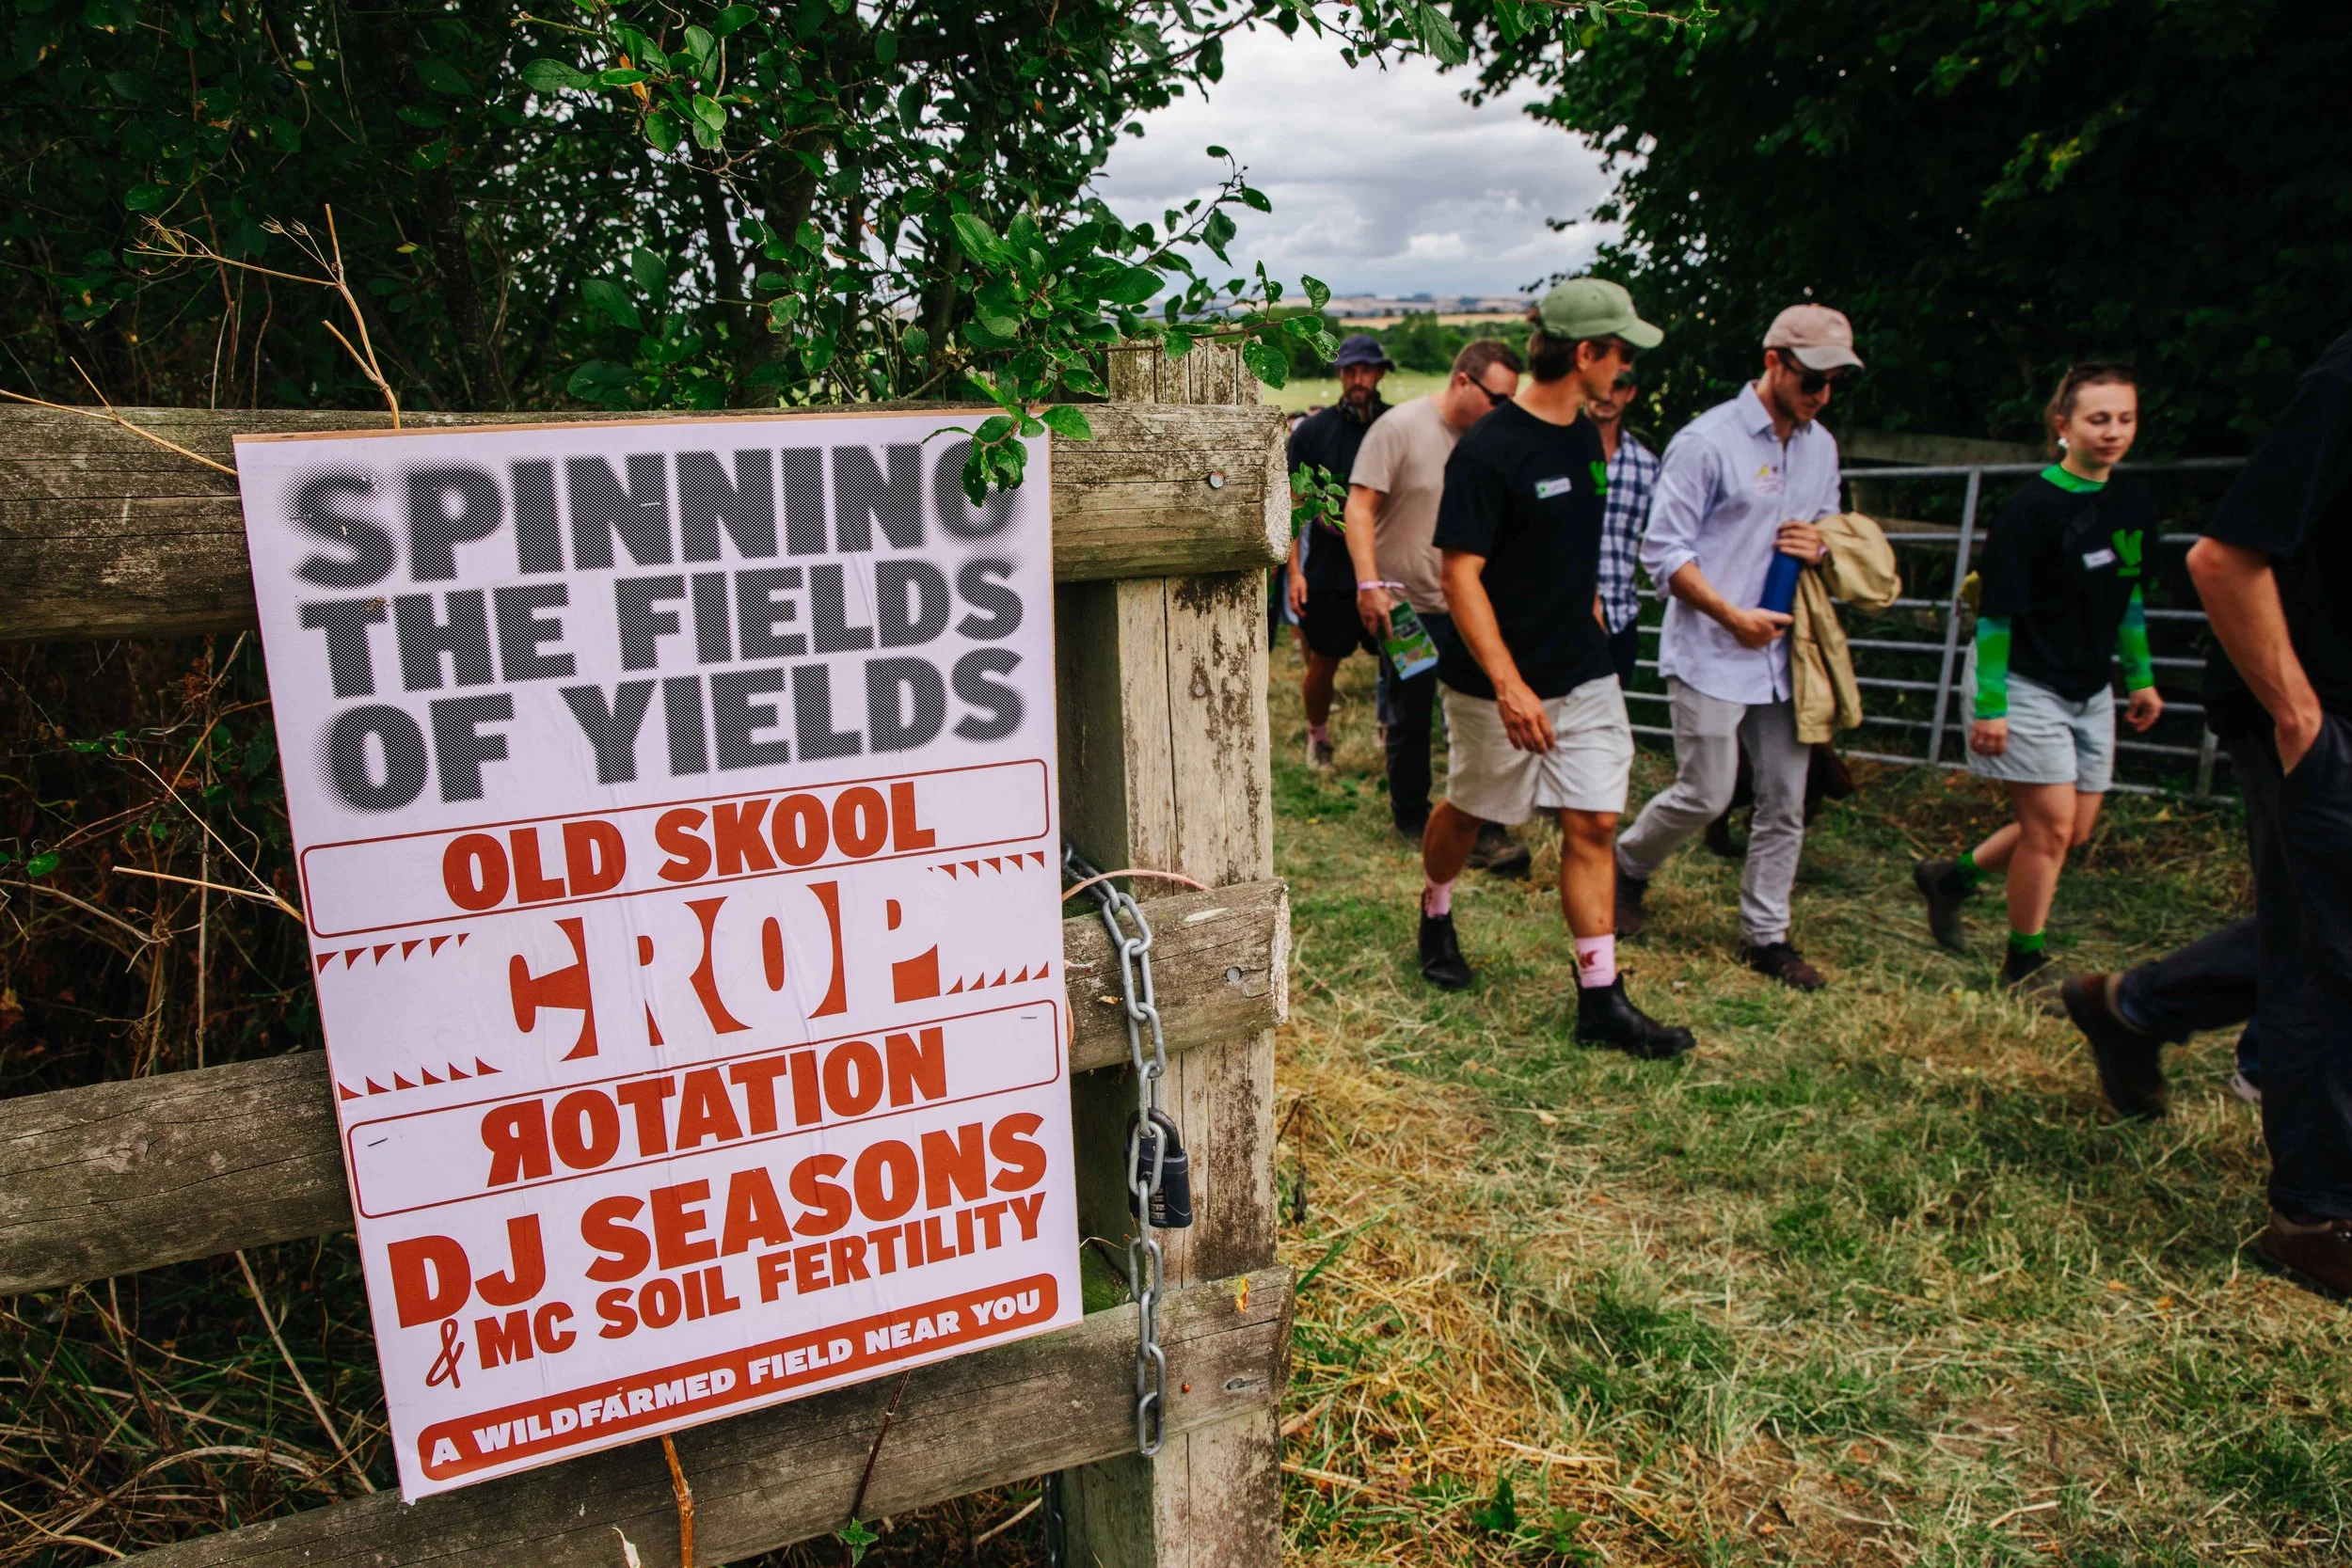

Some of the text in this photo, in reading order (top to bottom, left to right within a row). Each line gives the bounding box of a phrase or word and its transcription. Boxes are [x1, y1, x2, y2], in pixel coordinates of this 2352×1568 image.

[297, 557, 1022, 698] THE FIELDS
[318, 649, 1022, 812] OF YIELDS
[443, 783, 935, 910] OLD SKOOL
[494, 879, 941, 1062] CROP
[389, 1113, 1046, 1327] DJ SEASONS
[596, 1266, 739, 1338] SOIL
[757, 1193, 1044, 1302] FERTILITY
[431, 1289, 1040, 1467] A WILDFARMED FIELD NEAR YOU
